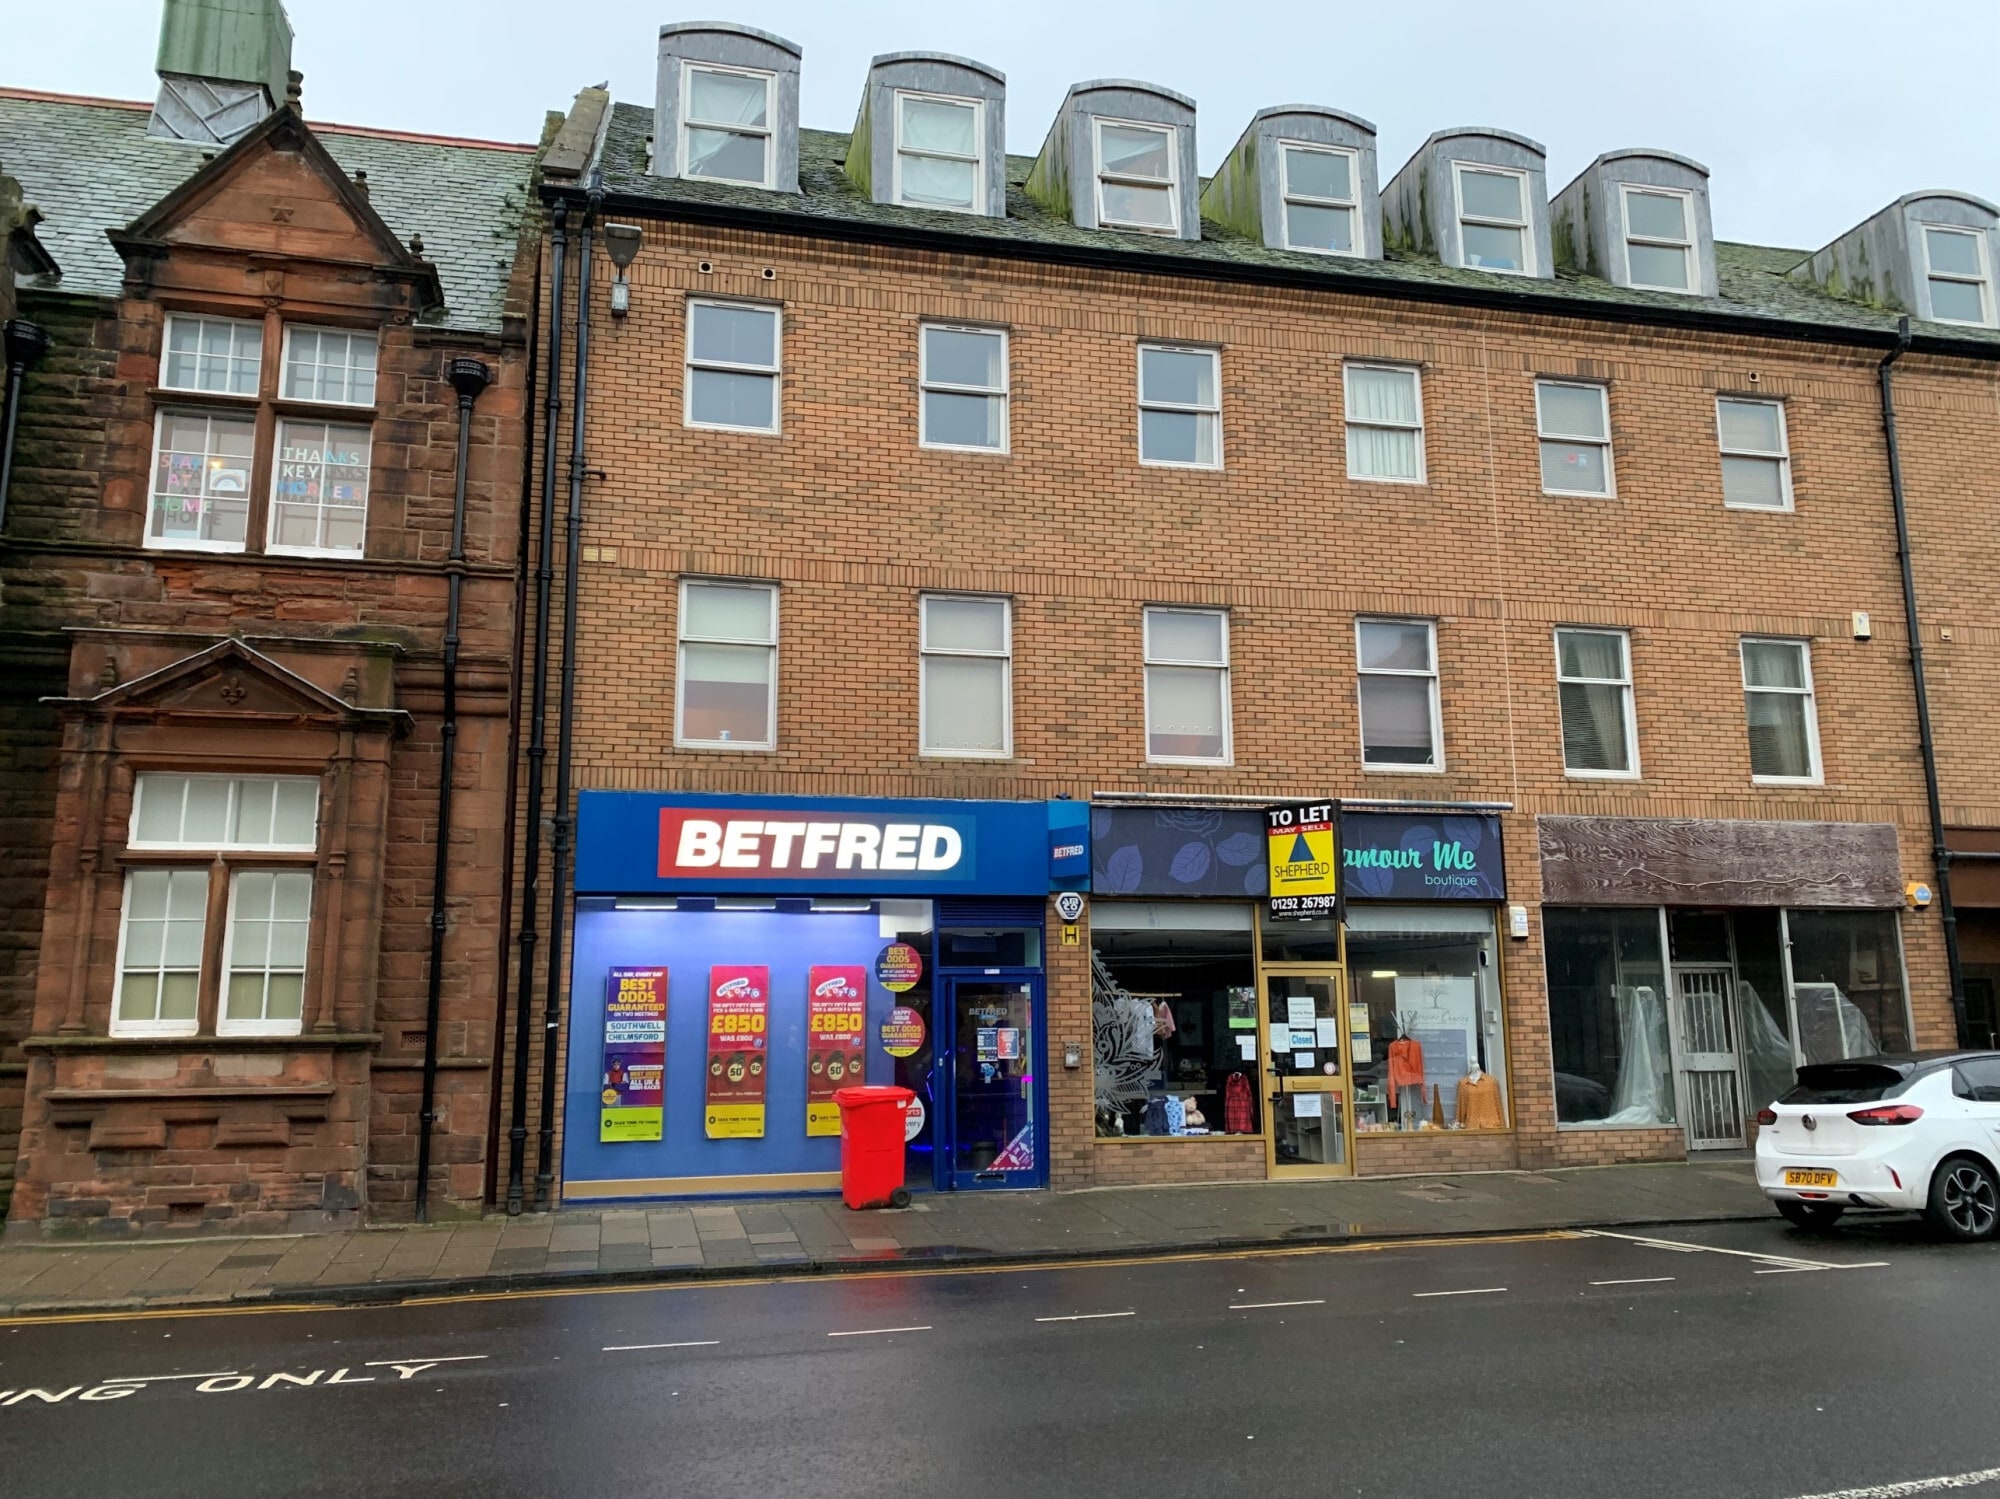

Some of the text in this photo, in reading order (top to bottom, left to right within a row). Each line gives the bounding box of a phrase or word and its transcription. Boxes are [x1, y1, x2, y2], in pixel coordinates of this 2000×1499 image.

[283, 447, 359, 465] THANKS
[283, 464, 320, 478] KEY
[168, 473, 192, 487] AT
[1269, 805, 1331, 826] TO LET
[1272, 826, 1297, 834] MAY
[675, 820, 962, 871] BETFRED
[1054, 844, 1084, 858] BETFRED
[1434, 840, 1476, 872] Me
[1274, 862, 1330, 878] SHEPHERD
[1425, 874, 1478, 888] boutique
[1272, 896, 1336, 910] 01292 267987
[1064, 927, 1077, 943] H
[888, 947, 909, 955] BEST
[620, 978, 655, 990] BEST
[618, 991, 656, 1002] ODDS
[608, 1004, 665, 1012] GUARANTEED
[712, 1014, 765, 1033] £850
[811, 1014, 862, 1032] £850
[1291, 1035, 1312, 1044] Closed
[730, 1068, 741, 1076] 50
[830, 1066, 841, 1074] 50
[1790, 1172, 1833, 1184] SB70 DFV
[196, 1363, 437, 1392] ONLY
